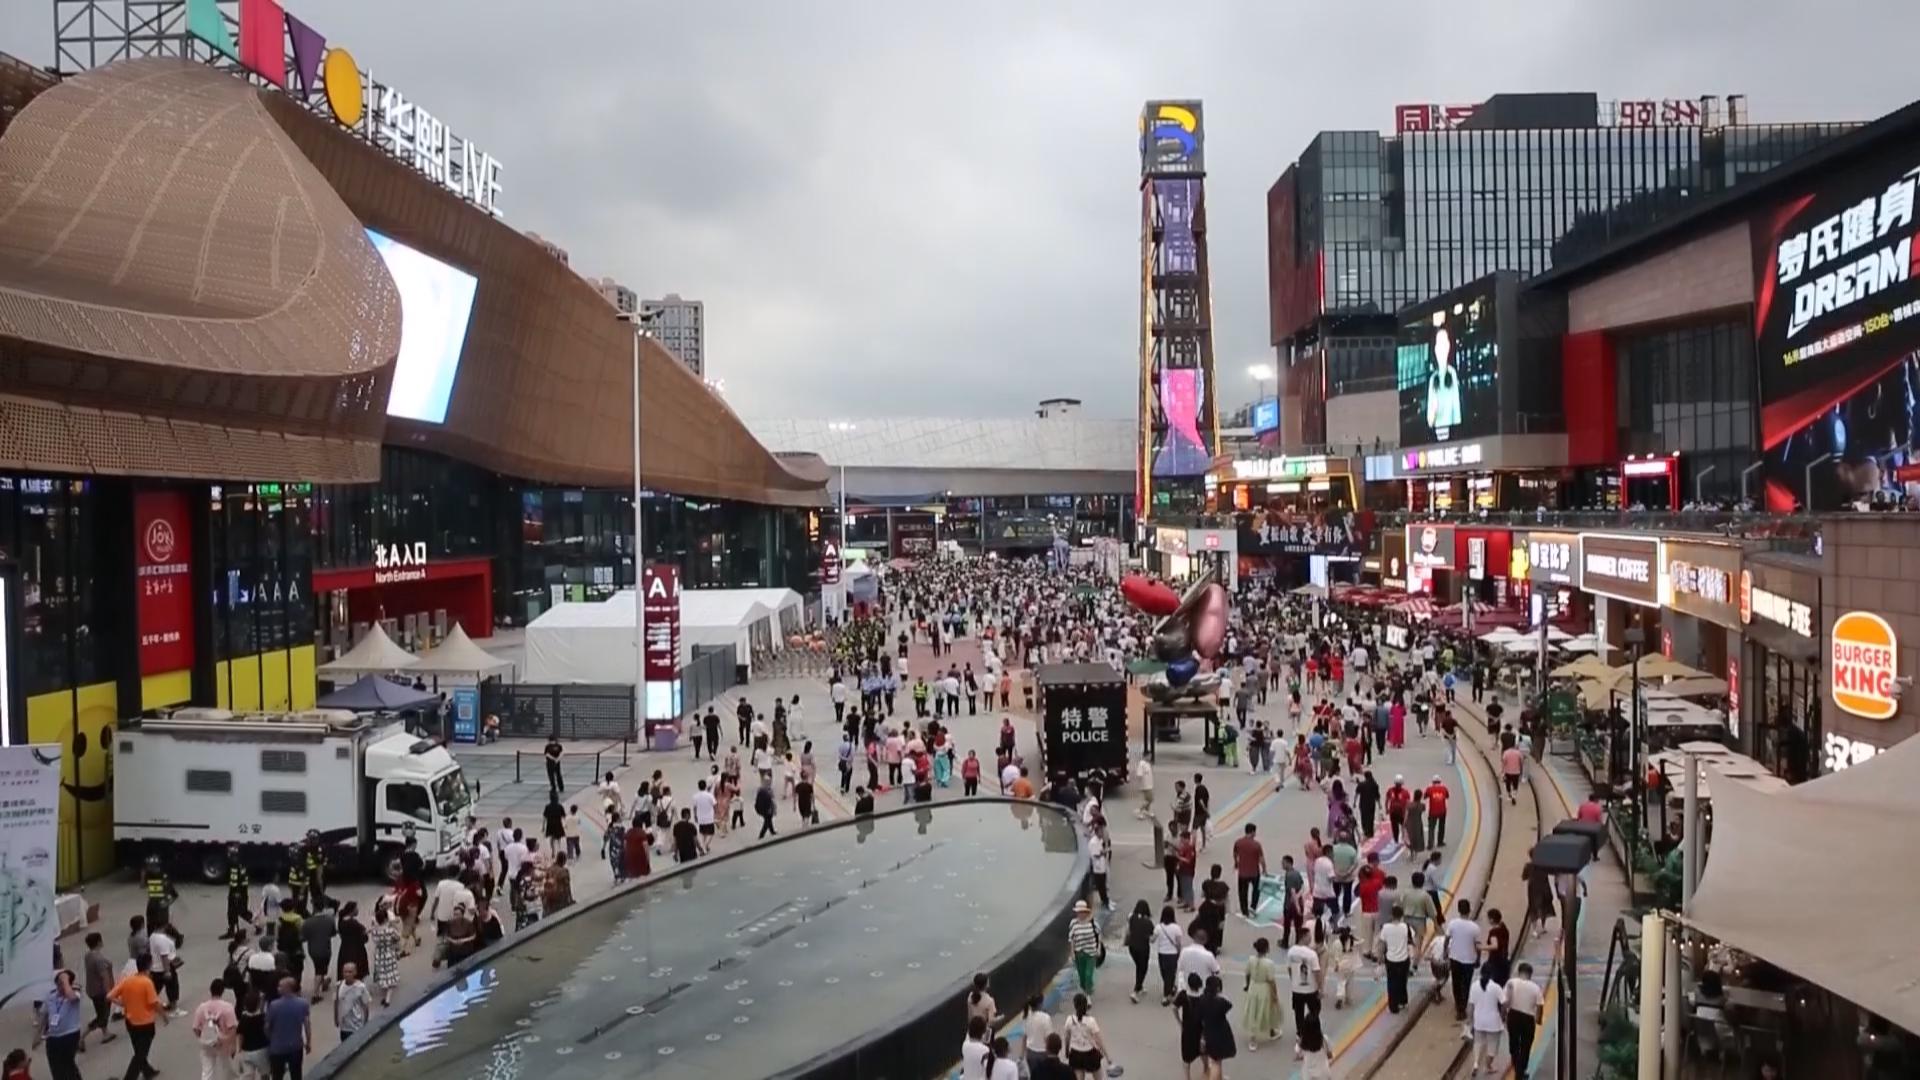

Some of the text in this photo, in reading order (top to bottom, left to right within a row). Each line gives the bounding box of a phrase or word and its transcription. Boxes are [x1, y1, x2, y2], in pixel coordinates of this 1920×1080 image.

[381, 87, 503, 217] 华熙LIVE
[375, 541, 427, 568] 北A入口
[375, 570, 393, 583] North
[394, 569, 420, 582] Entrance
[1618, 557, 1649, 583] COFFEE
[648, 577, 667, 599] A
[1834, 643, 1892, 669] BURGER
[1834, 664, 1893, 699] KING
[1061, 706, 1109, 729] 特警
[1062, 731, 1109, 744] POLICE
[1825, 732, 1887, 772] 汉堡
[238, 823, 262, 834] 公安
